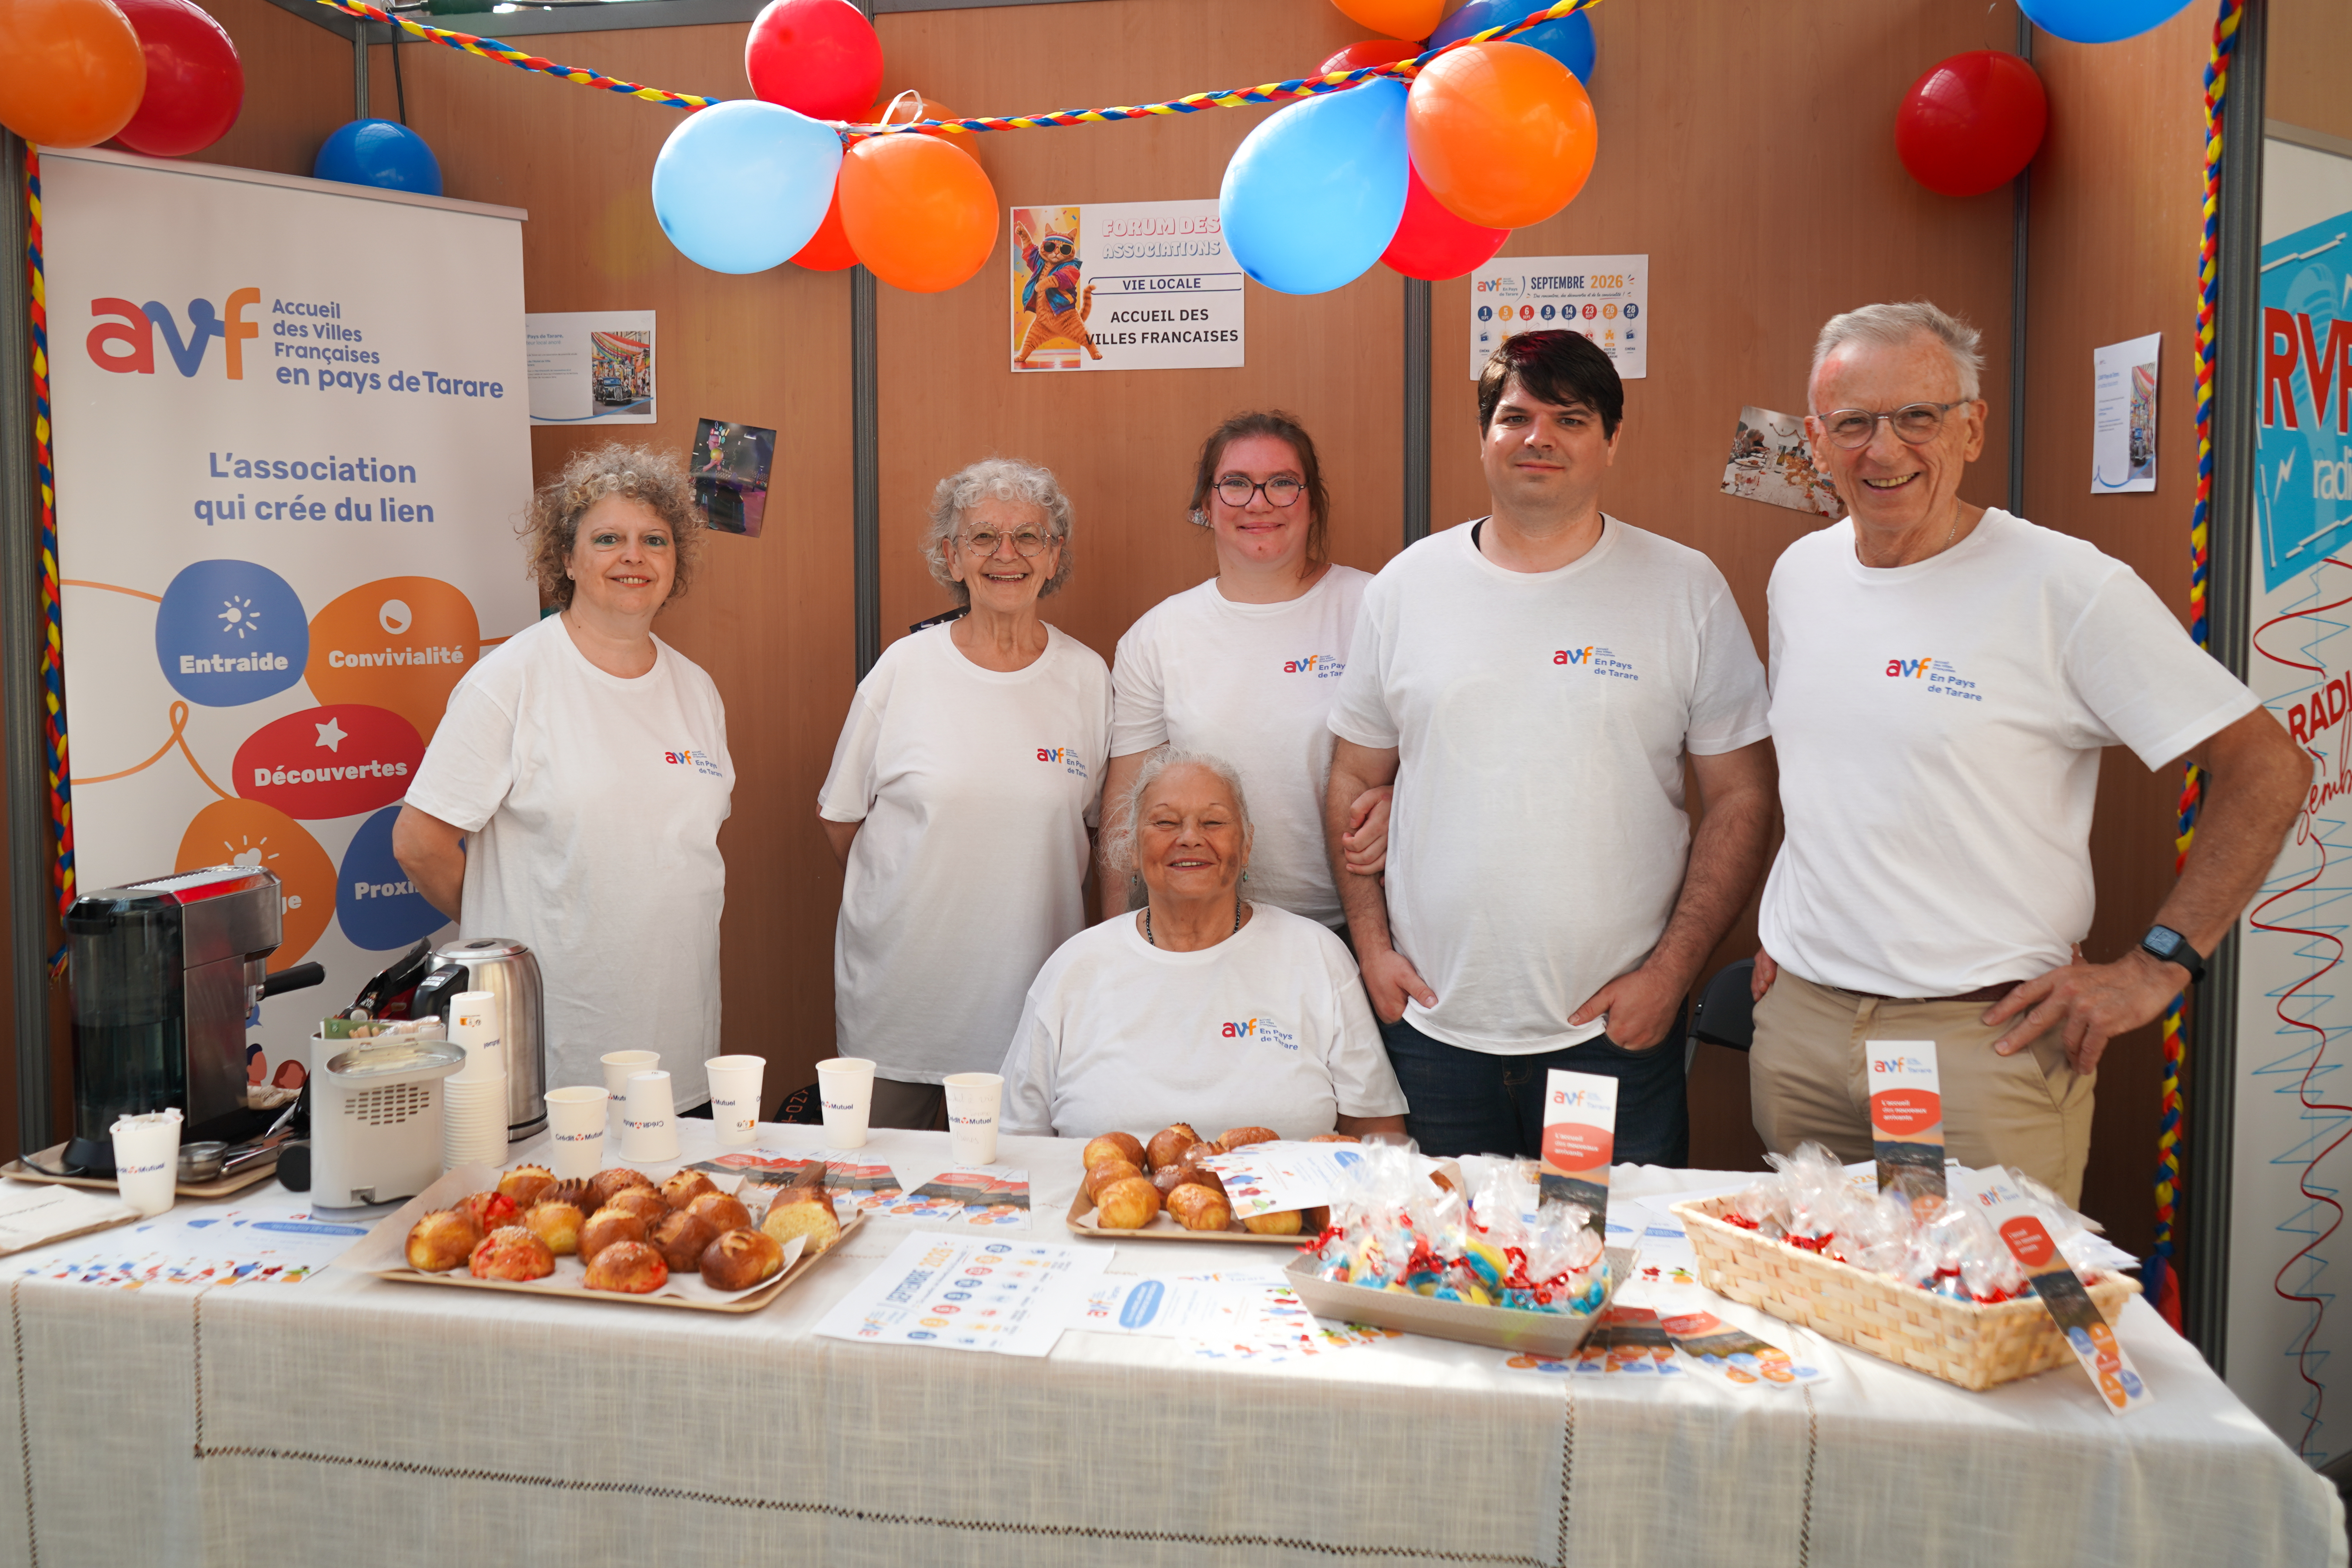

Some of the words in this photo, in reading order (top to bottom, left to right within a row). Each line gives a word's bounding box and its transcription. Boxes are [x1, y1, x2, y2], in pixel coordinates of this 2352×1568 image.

[1102, 217, 1175, 237] FORUM
[1179, 215, 1221, 235] DES
[1102, 240, 1221, 259] ASSOCIATIONS
[1123, 279, 1145, 290] VIE
[1150, 278, 1201, 289] LOCALE
[1477, 278, 1502, 292] avf
[1531, 275, 1584, 290] SEPTEMBRE
[1590, 275, 1623, 289] 2026
[272, 299, 341, 319] Accueil
[1111, 310, 1175, 323] ACCUEIL
[1180, 309, 1209, 321] DES
[1483, 308, 1487, 316] 1
[1546, 306, 1551, 315] 9
[1606, 306, 1614, 314] 26
[86, 287, 261, 380] avf
[272, 320, 309, 339] des
[312, 324, 362, 342] Villes
[1085, 333, 1137, 345] VILLES
[1142, 330, 1238, 344] FRANCAISES
[274, 342, 380, 365] Françaises
[275, 366, 310, 386] en
[318, 367, 381, 394] pays
[388, 367, 421, 393] de
[422, 370, 504, 398] Tarare
[209, 452, 416, 483] L'association
[194, 494, 246, 526] qui
[255, 494, 326, 521] crée
[334, 497, 371, 522] du
[381, 497, 434, 522] lien
[180, 651, 289, 674] Entraide
[329, 645, 464, 668] Convivialité
[1284, 655, 1318, 673] avf
[1553, 646, 1594, 665] avf
[1610, 660, 1632, 670] Pays
[1886, 658, 1932, 679] avf
[1609, 669, 1638, 681] Tarare
[1930, 673, 1945, 682] En
[1947, 676, 1976, 688] Pays
[1927, 685, 1942, 693] de
[1945, 687, 1982, 702] Tarare
[665, 750, 691, 765] avf
[1037, 748, 1064, 764] avf
[255, 760, 408, 787] Découvertes
[355, 880, 420, 900] Proxi
[1222, 1018, 1257, 1038] avf
[1273, 1030, 1293, 1040] Pays
[1273, 1036, 1298, 1050] Tarare
[1874, 1057, 1905, 1074] avf
[1553, 1090, 1585, 1106] avf
